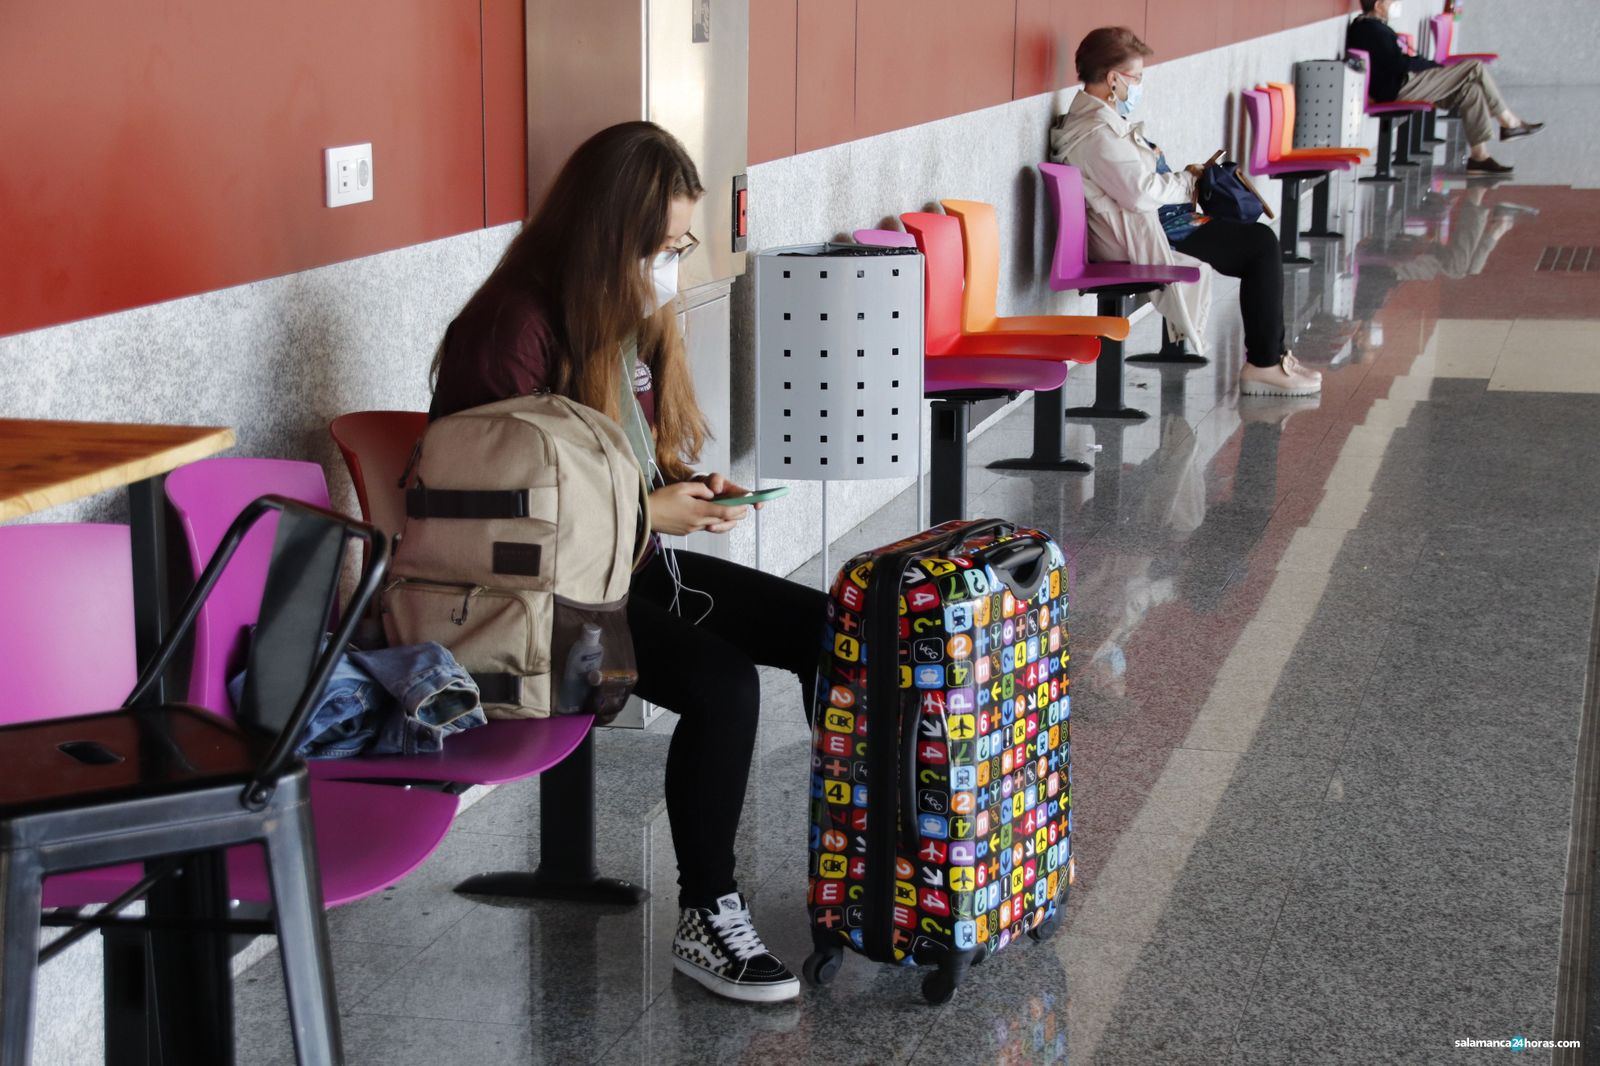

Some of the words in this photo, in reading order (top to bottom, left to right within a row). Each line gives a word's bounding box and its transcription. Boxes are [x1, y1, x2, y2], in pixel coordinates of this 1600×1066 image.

[912, 592, 935, 606] 4
[839, 639, 852, 657] 4
[953, 637, 967, 657] 2
[831, 689, 851, 703] 2
[922, 746, 944, 759] 4
[828, 784, 844, 801] 4
[957, 795, 970, 811] 2
[956, 819, 971, 837] 4
[825, 834, 844, 848] 2
[923, 894, 946, 909] 4
